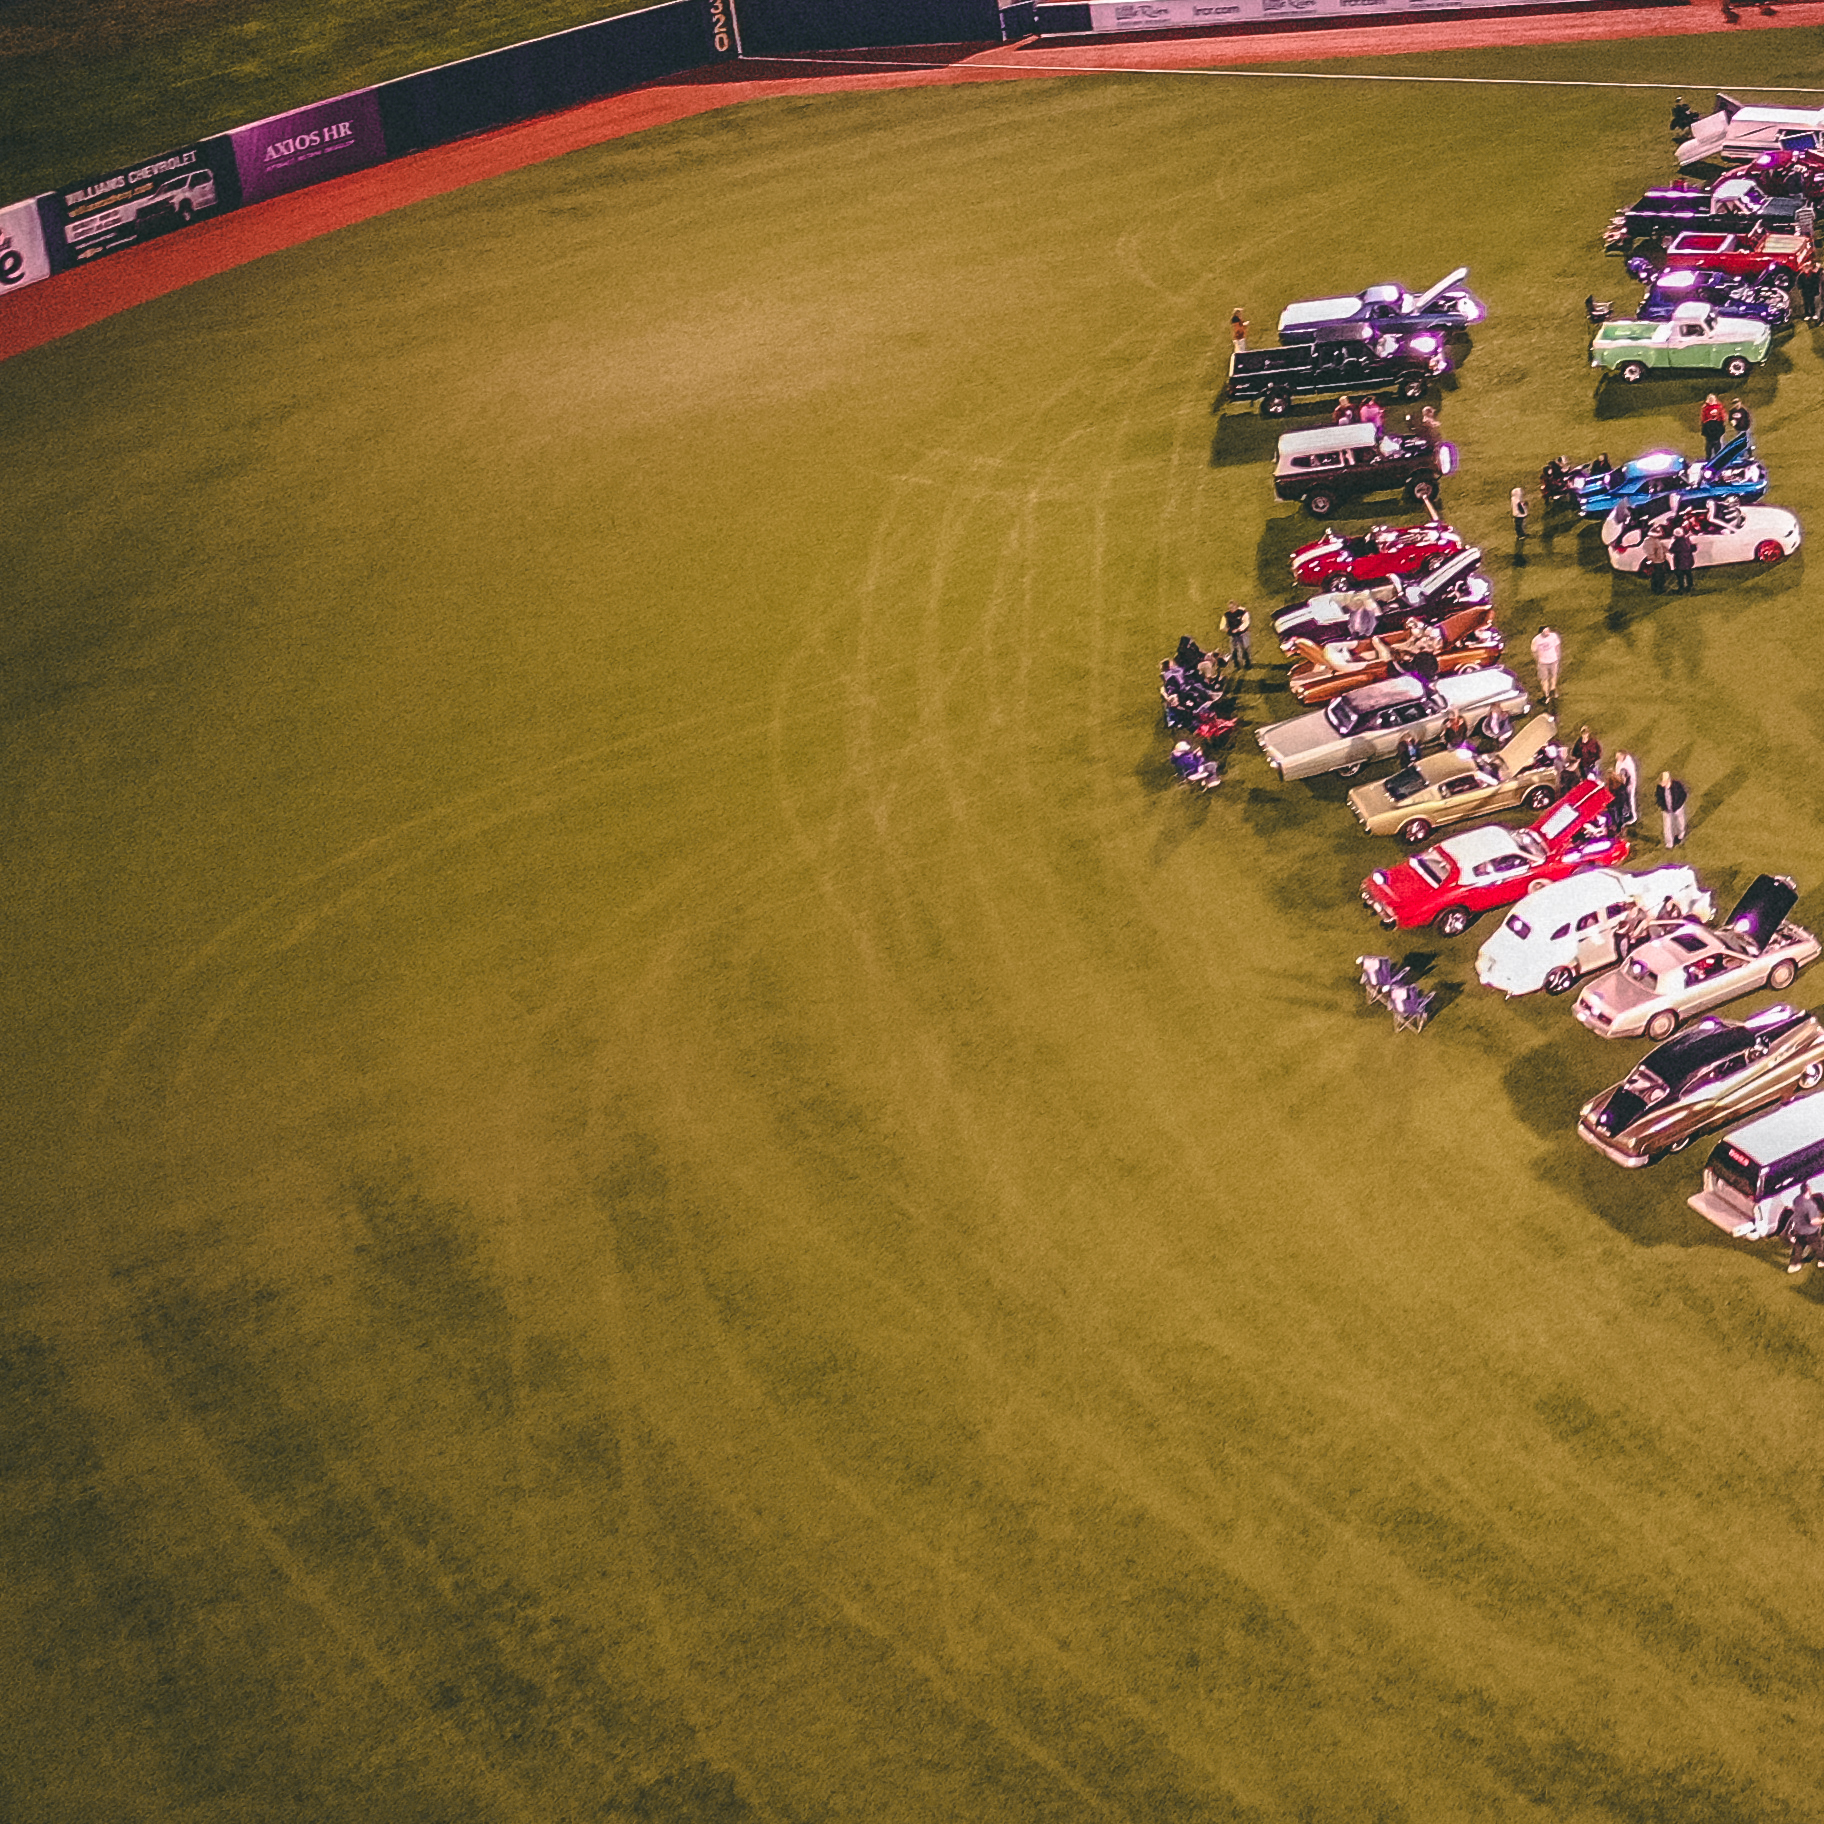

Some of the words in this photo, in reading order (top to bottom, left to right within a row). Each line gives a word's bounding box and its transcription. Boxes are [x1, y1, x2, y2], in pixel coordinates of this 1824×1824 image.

[264, 130, 321, 162] AXIOS
[323, 121, 352, 143] HR
[127, 150, 197, 184] CHEVROLET
